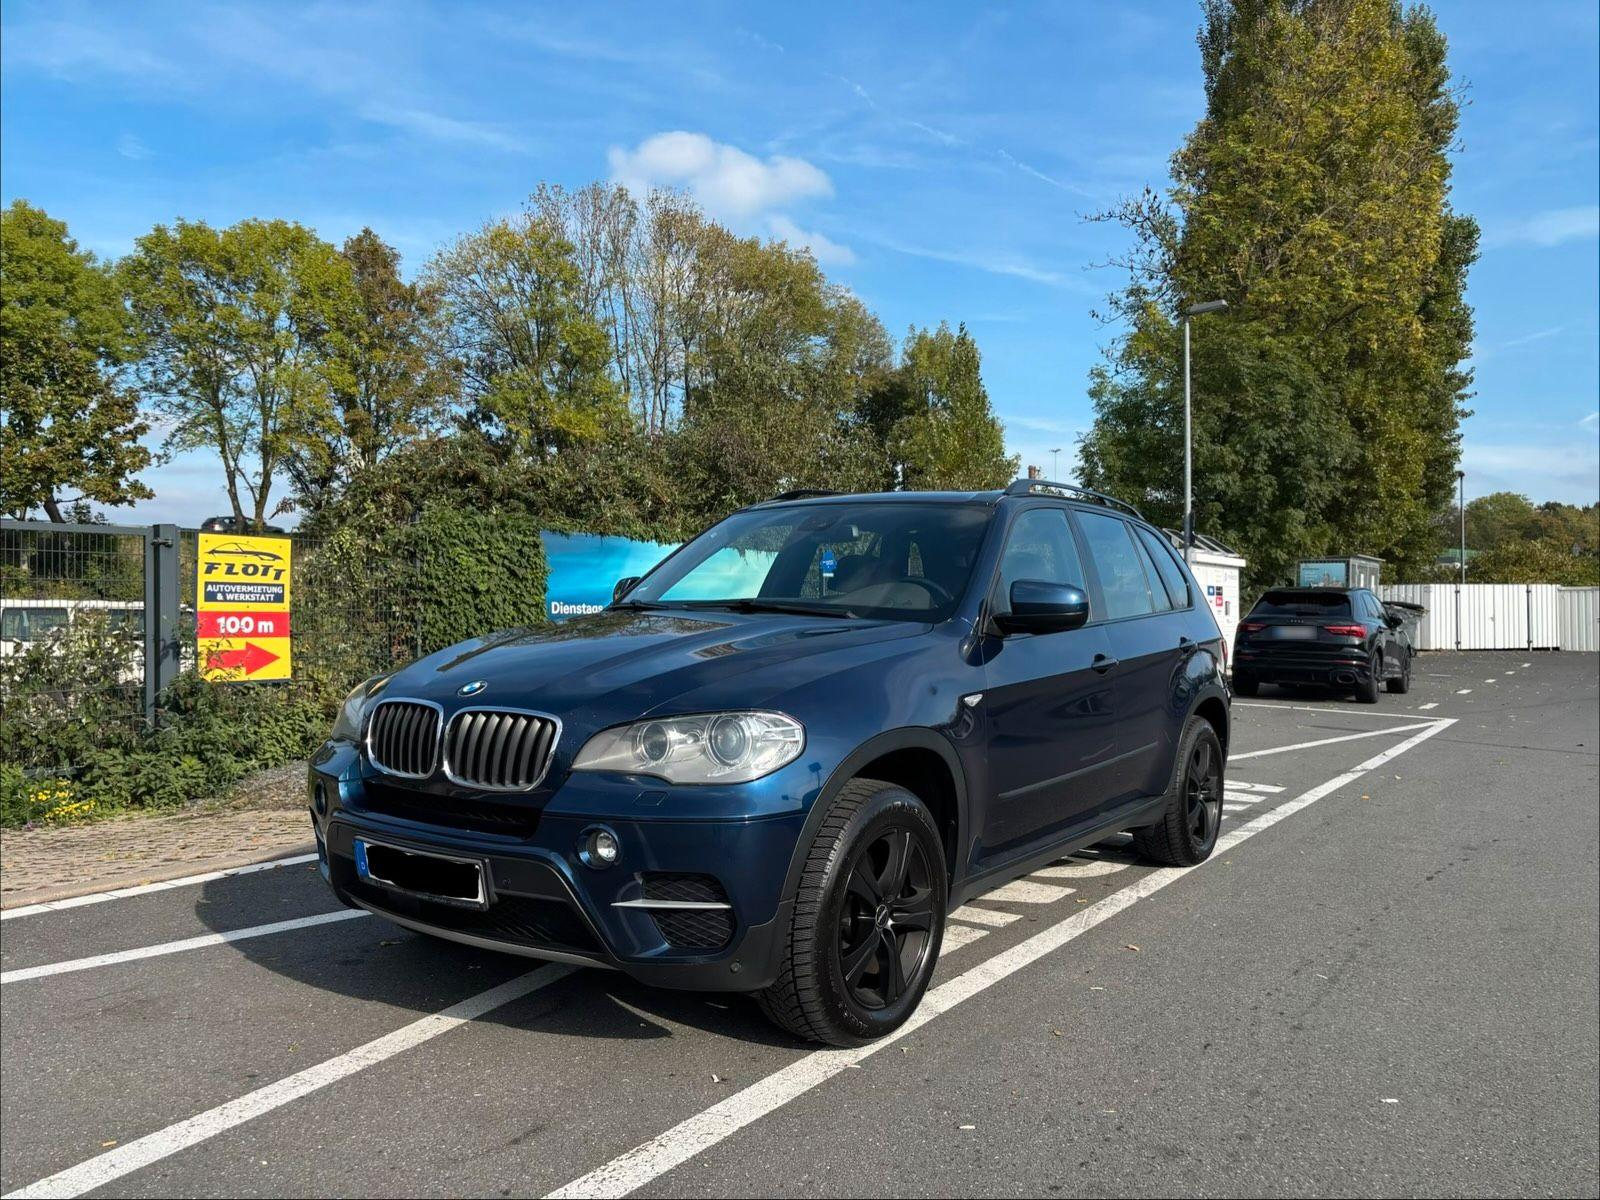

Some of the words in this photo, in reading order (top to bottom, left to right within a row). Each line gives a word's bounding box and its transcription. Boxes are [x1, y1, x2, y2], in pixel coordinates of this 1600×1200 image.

[204, 562, 285, 580] FLOTT
[207, 584, 282, 593] AUTOVERMIETUNG
[216, 593, 224, 601] &
[226, 593, 274, 601] WERKSTATT
[216, 616, 254, 633] 100
[258, 620, 274, 633] m
